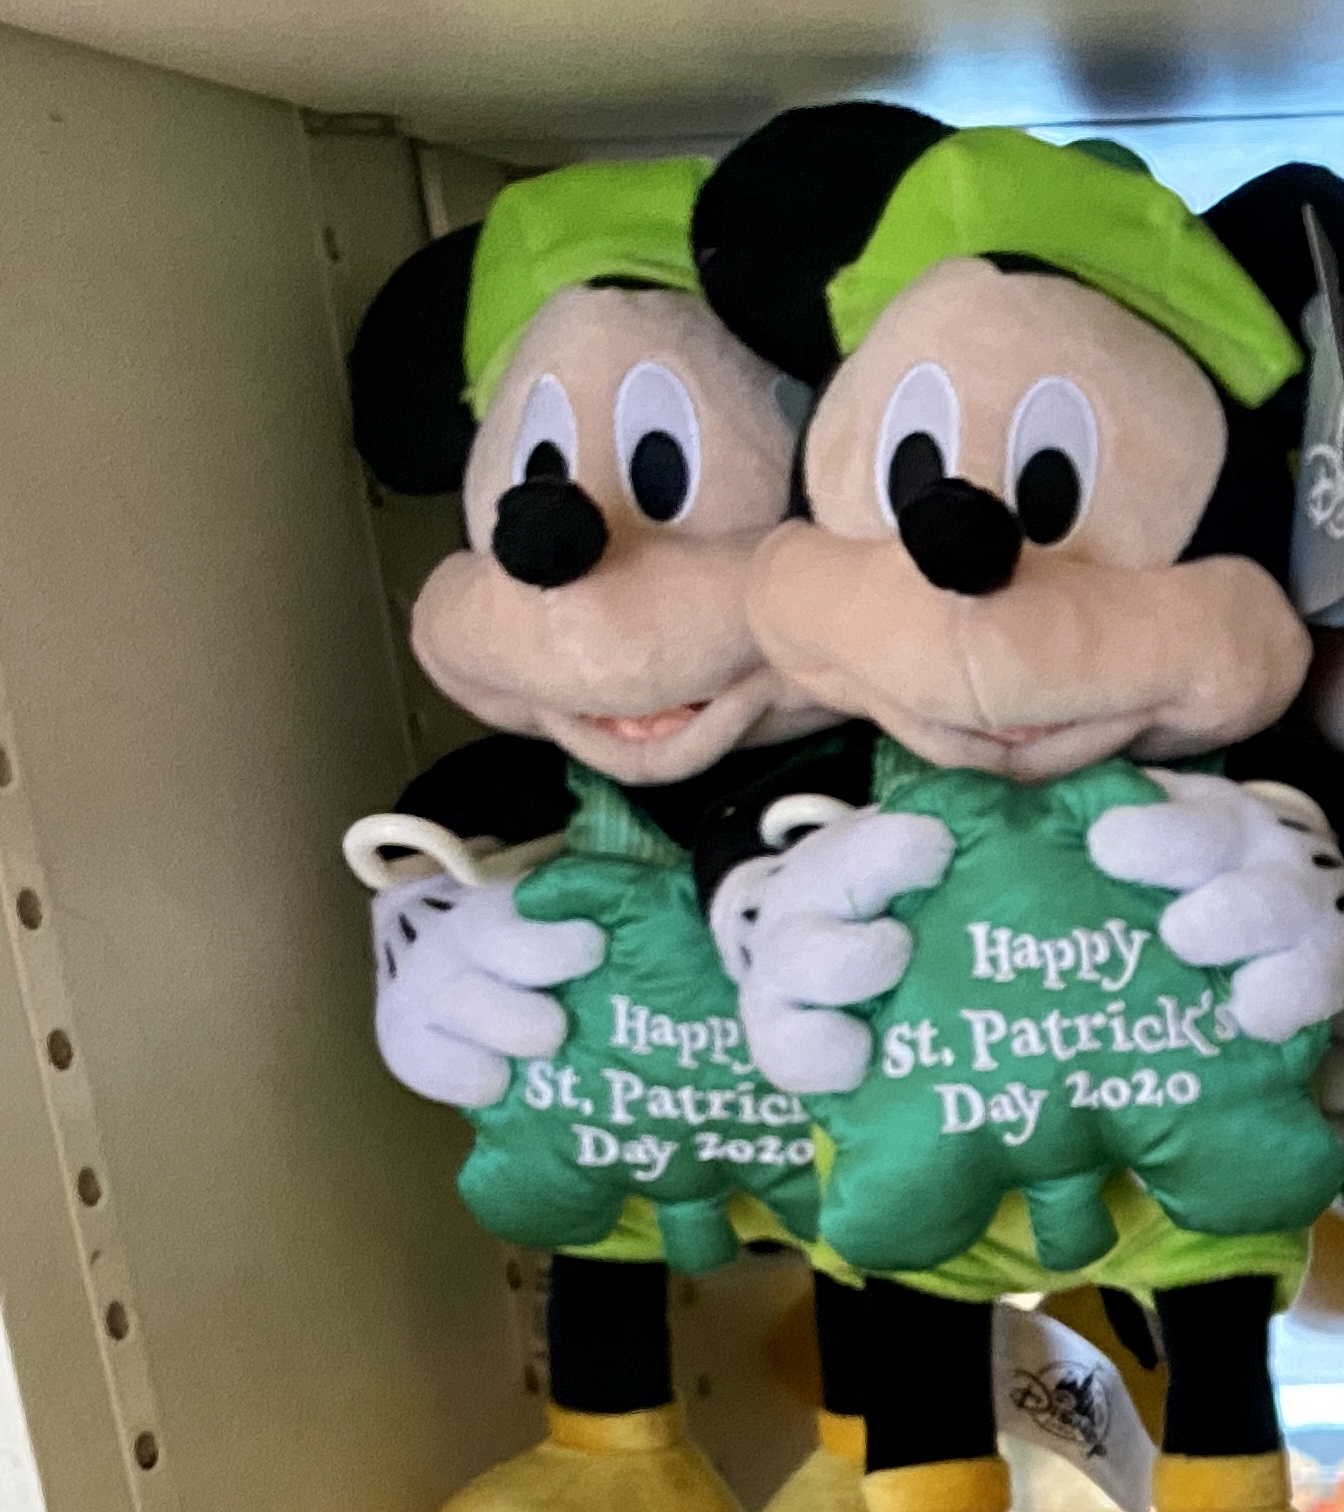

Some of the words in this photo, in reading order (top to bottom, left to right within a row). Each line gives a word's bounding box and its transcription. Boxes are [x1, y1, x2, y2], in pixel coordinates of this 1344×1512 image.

[967, 918, 1151, 992] Happy
[610, 994, 756, 1075] Happ
[882, 1018, 954, 1078] St.
[960, 989, 1241, 1062] Patrick's
[525, 1061, 594, 1116] St.
[933, 1081, 1049, 1147] Day
[1065, 1068, 1201, 1110] 2020
[572, 1123, 680, 1182] Day
[694, 1131, 815, 1166] 2020
